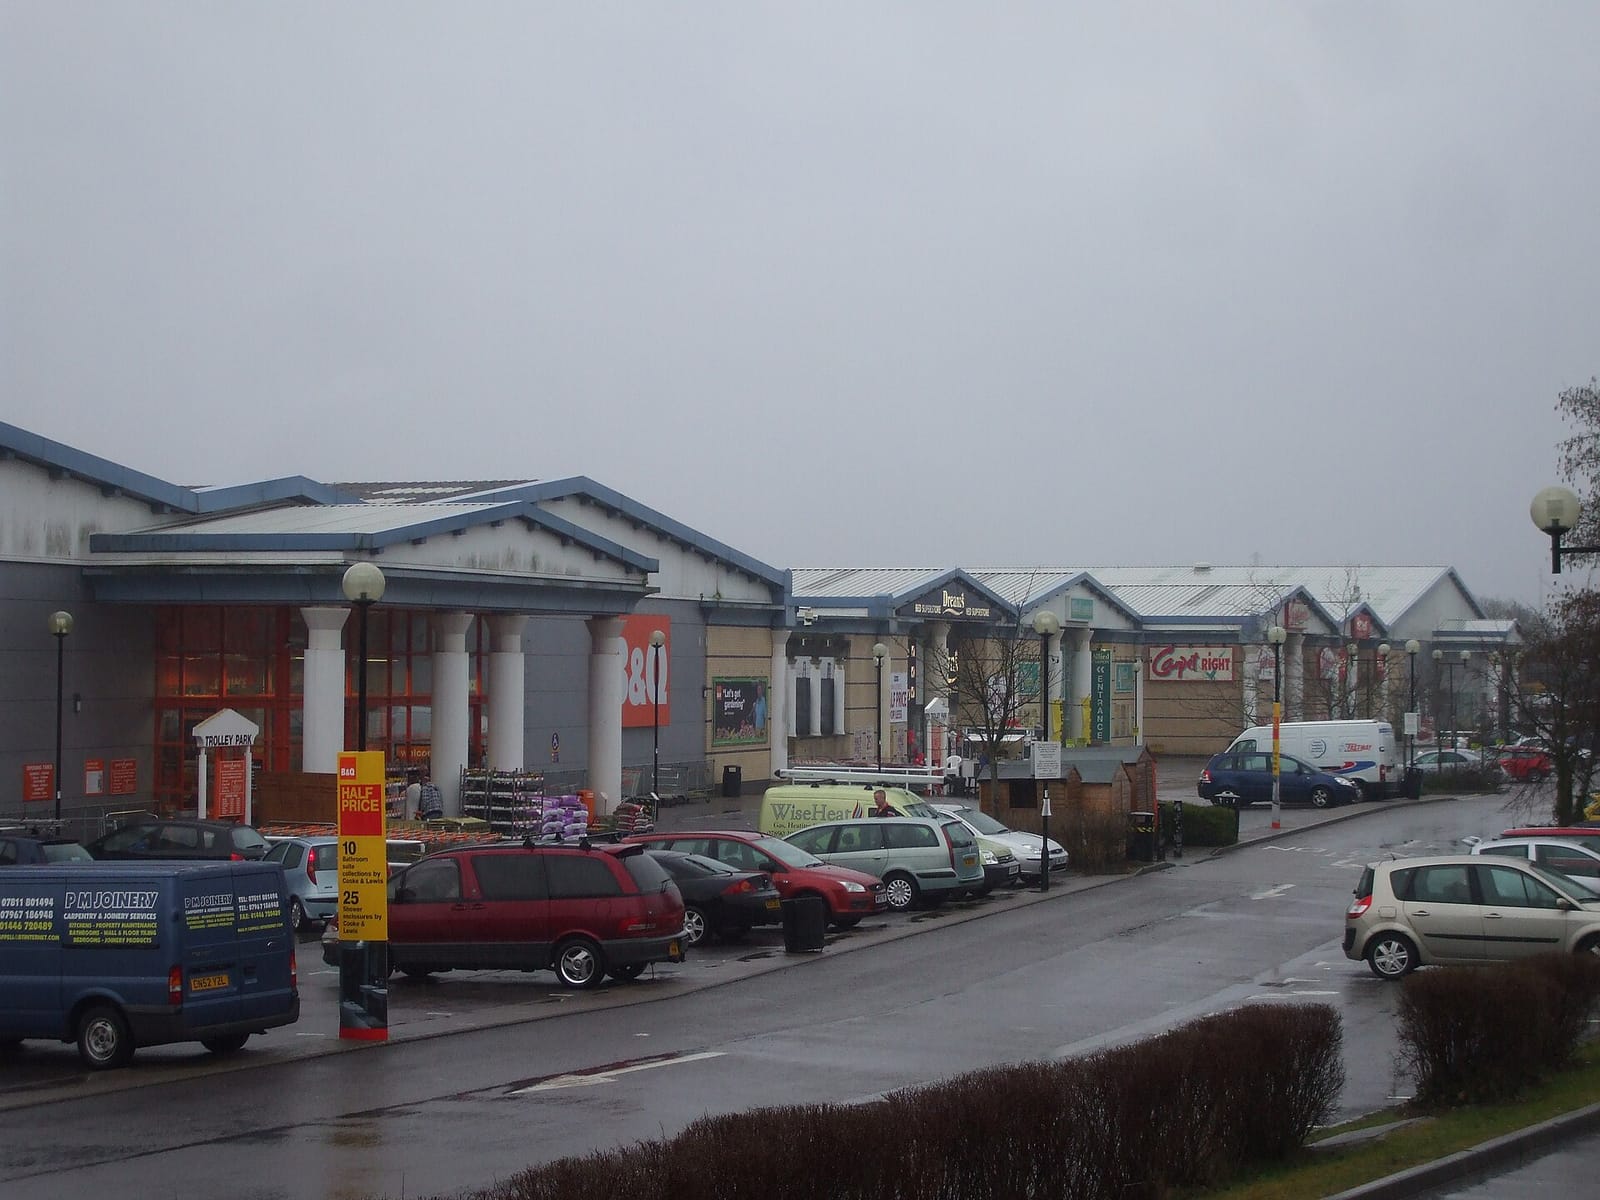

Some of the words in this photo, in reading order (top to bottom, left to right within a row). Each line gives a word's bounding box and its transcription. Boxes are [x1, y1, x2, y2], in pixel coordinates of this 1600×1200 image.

[1096, 675, 1105, 740] ENTRANCE
[205, 735, 234, 747] TROLLEY
[235, 734, 253, 746] PARK
[341, 767, 355, 776] B&Q
[341, 786, 373, 799] HALF
[341, 799, 380, 812] PRICE
[342, 841, 356, 855] 10
[373, 871, 381, 879] by
[1, 898, 24, 907] 07811
[65, 892, 76, 909] P
[77, 892, 92, 910] M
[93, 892, 159, 909] JOINERY
[185, 898, 192, 909] P
[191, 896, 201, 908] M
[200, 894, 233, 907] JOINERY
[343, 890, 360, 905] 25
[0, 910, 24, 919] 07967
[63, 912, 97, 920] CARPENTRY
[103, 912, 129, 920] JOINERY
[129, 912, 157, 920] SERVICES
